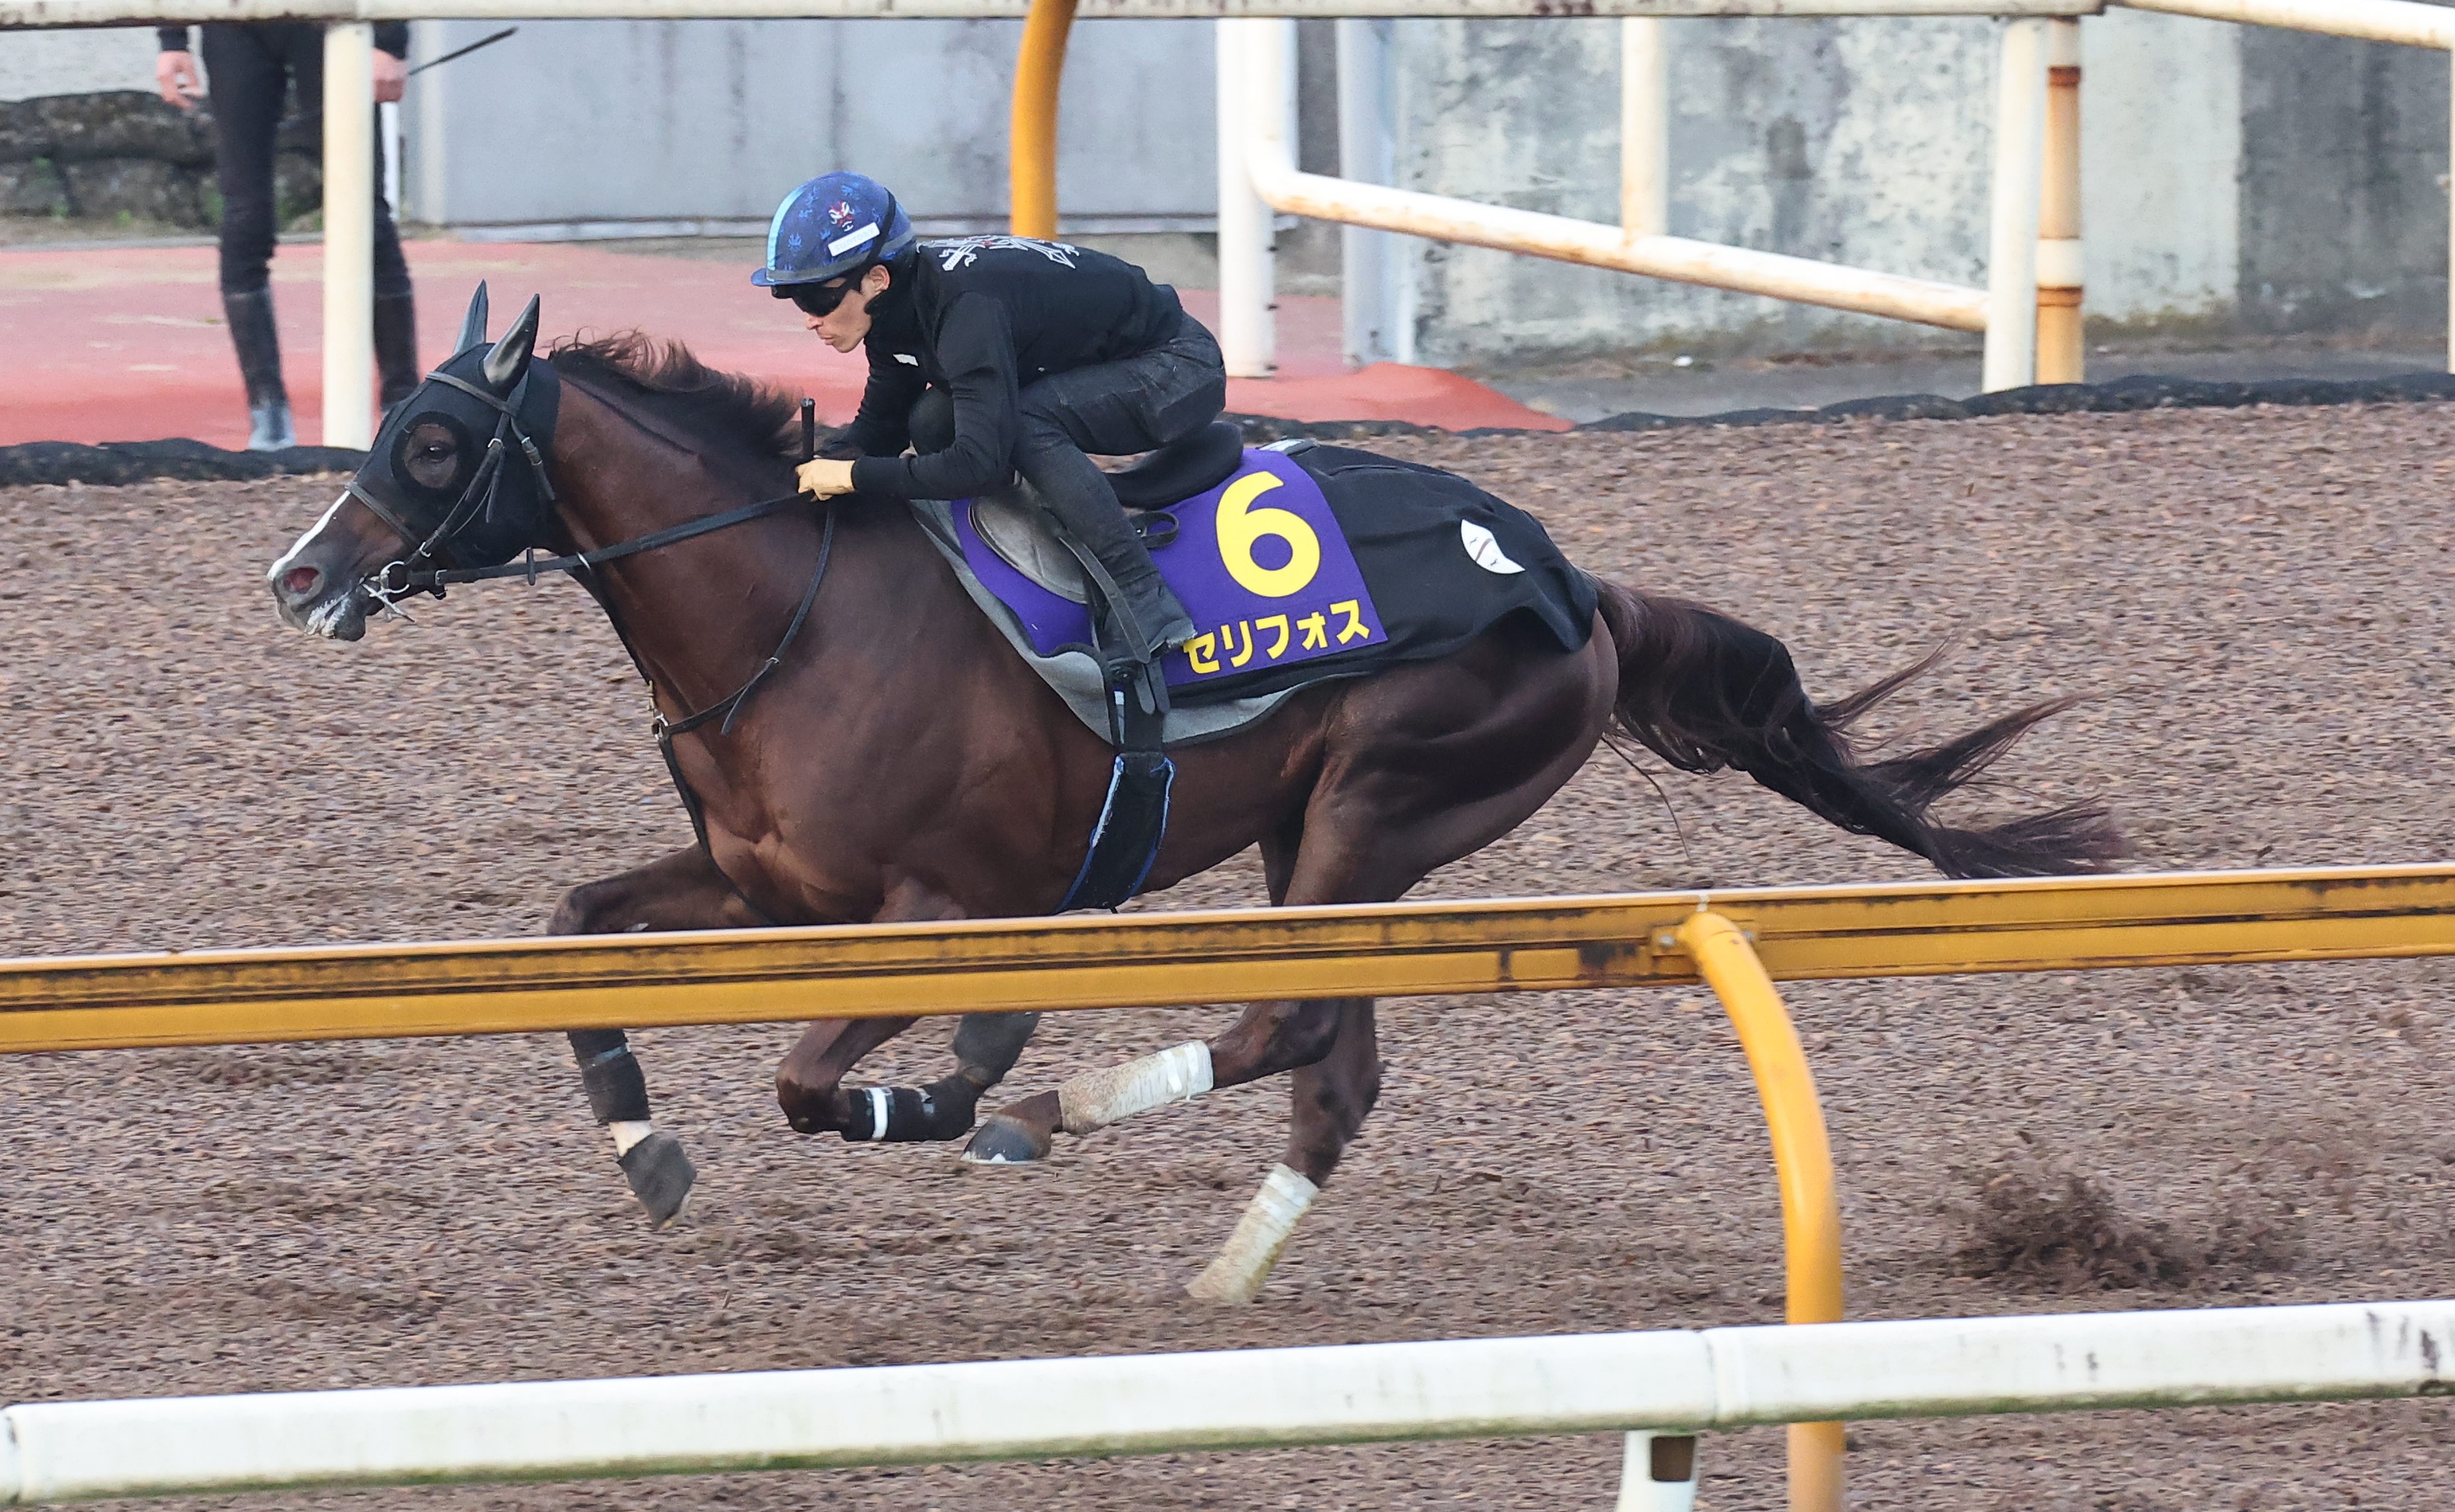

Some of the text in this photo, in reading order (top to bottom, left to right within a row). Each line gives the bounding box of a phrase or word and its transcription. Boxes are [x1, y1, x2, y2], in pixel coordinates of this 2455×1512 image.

[1215, 471, 1321, 598] 6
[1183, 599, 1371, 674] セリフォス
